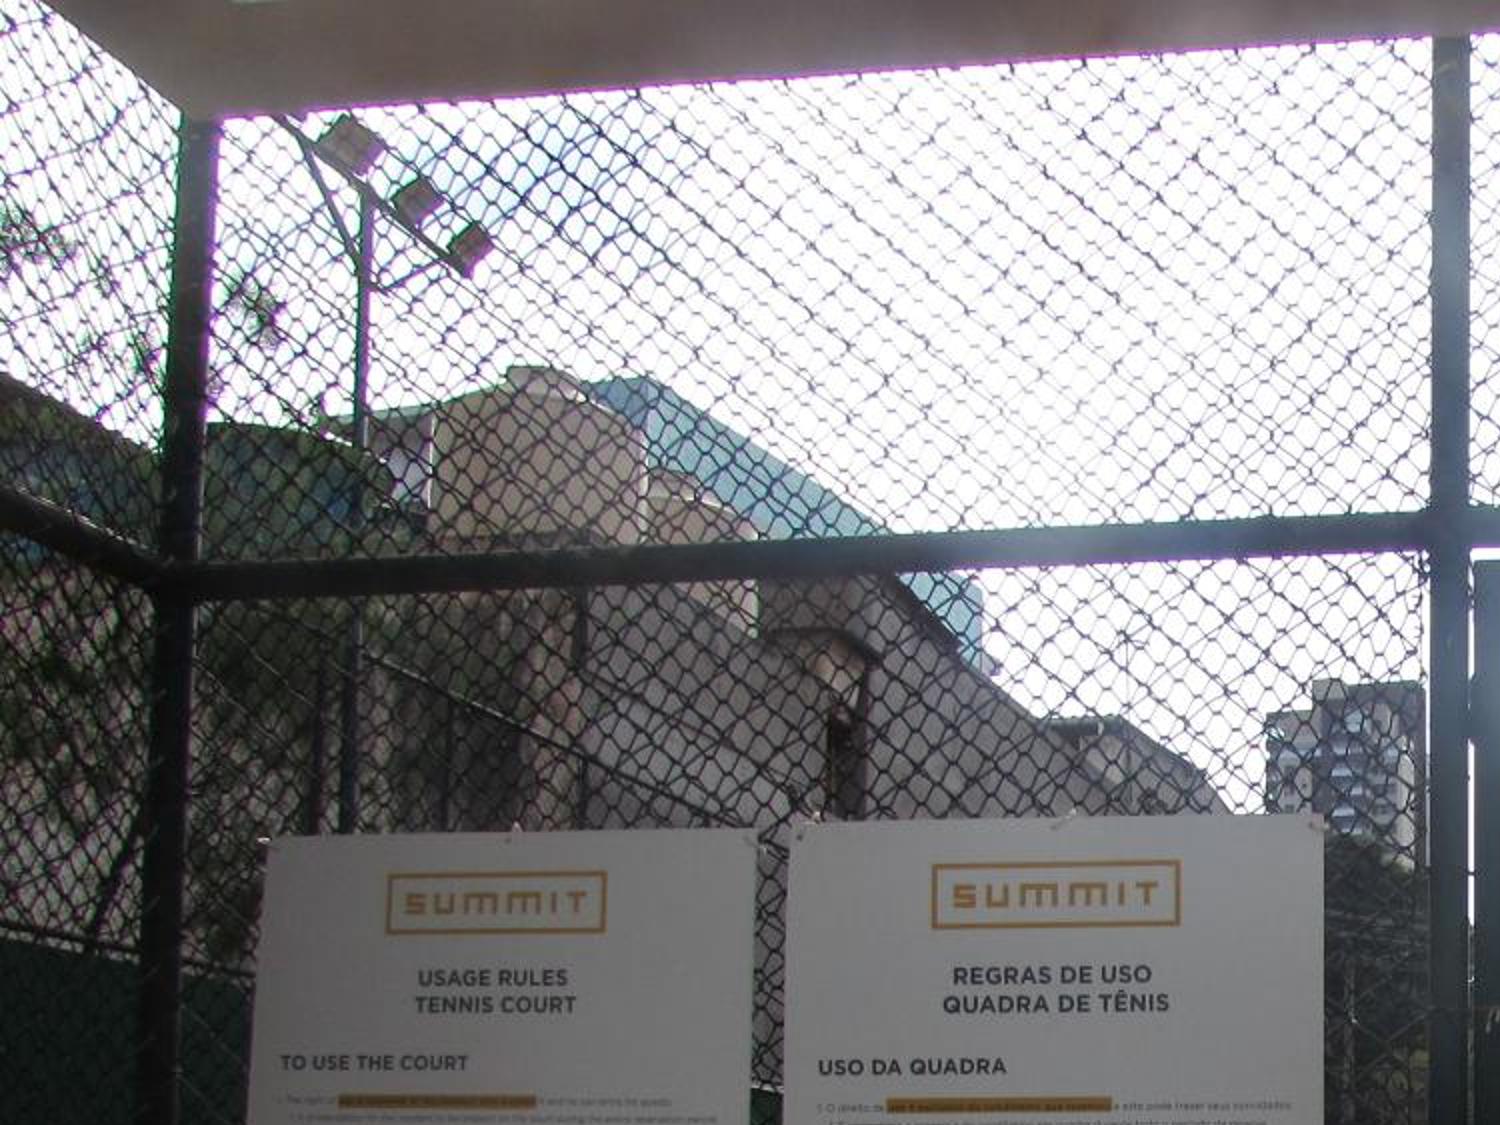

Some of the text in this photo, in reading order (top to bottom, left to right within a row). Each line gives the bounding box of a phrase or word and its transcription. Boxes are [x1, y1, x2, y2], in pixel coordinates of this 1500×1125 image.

[404, 890, 588, 917] SUMMIT
[951, 881, 1158, 910] SUMMIT
[417, 968, 568, 988] USAGE RULES
[953, 964, 1153, 986] REGRAS DE USO
[415, 994, 577, 1015] TENNIS COURT
[942, 989, 1170, 1015] QUADRA DE TÊNIS
[279, 1053, 469, 1072] TO USE THE COURT
[818, 1057, 1007, 1077] USO DA QUADRA
